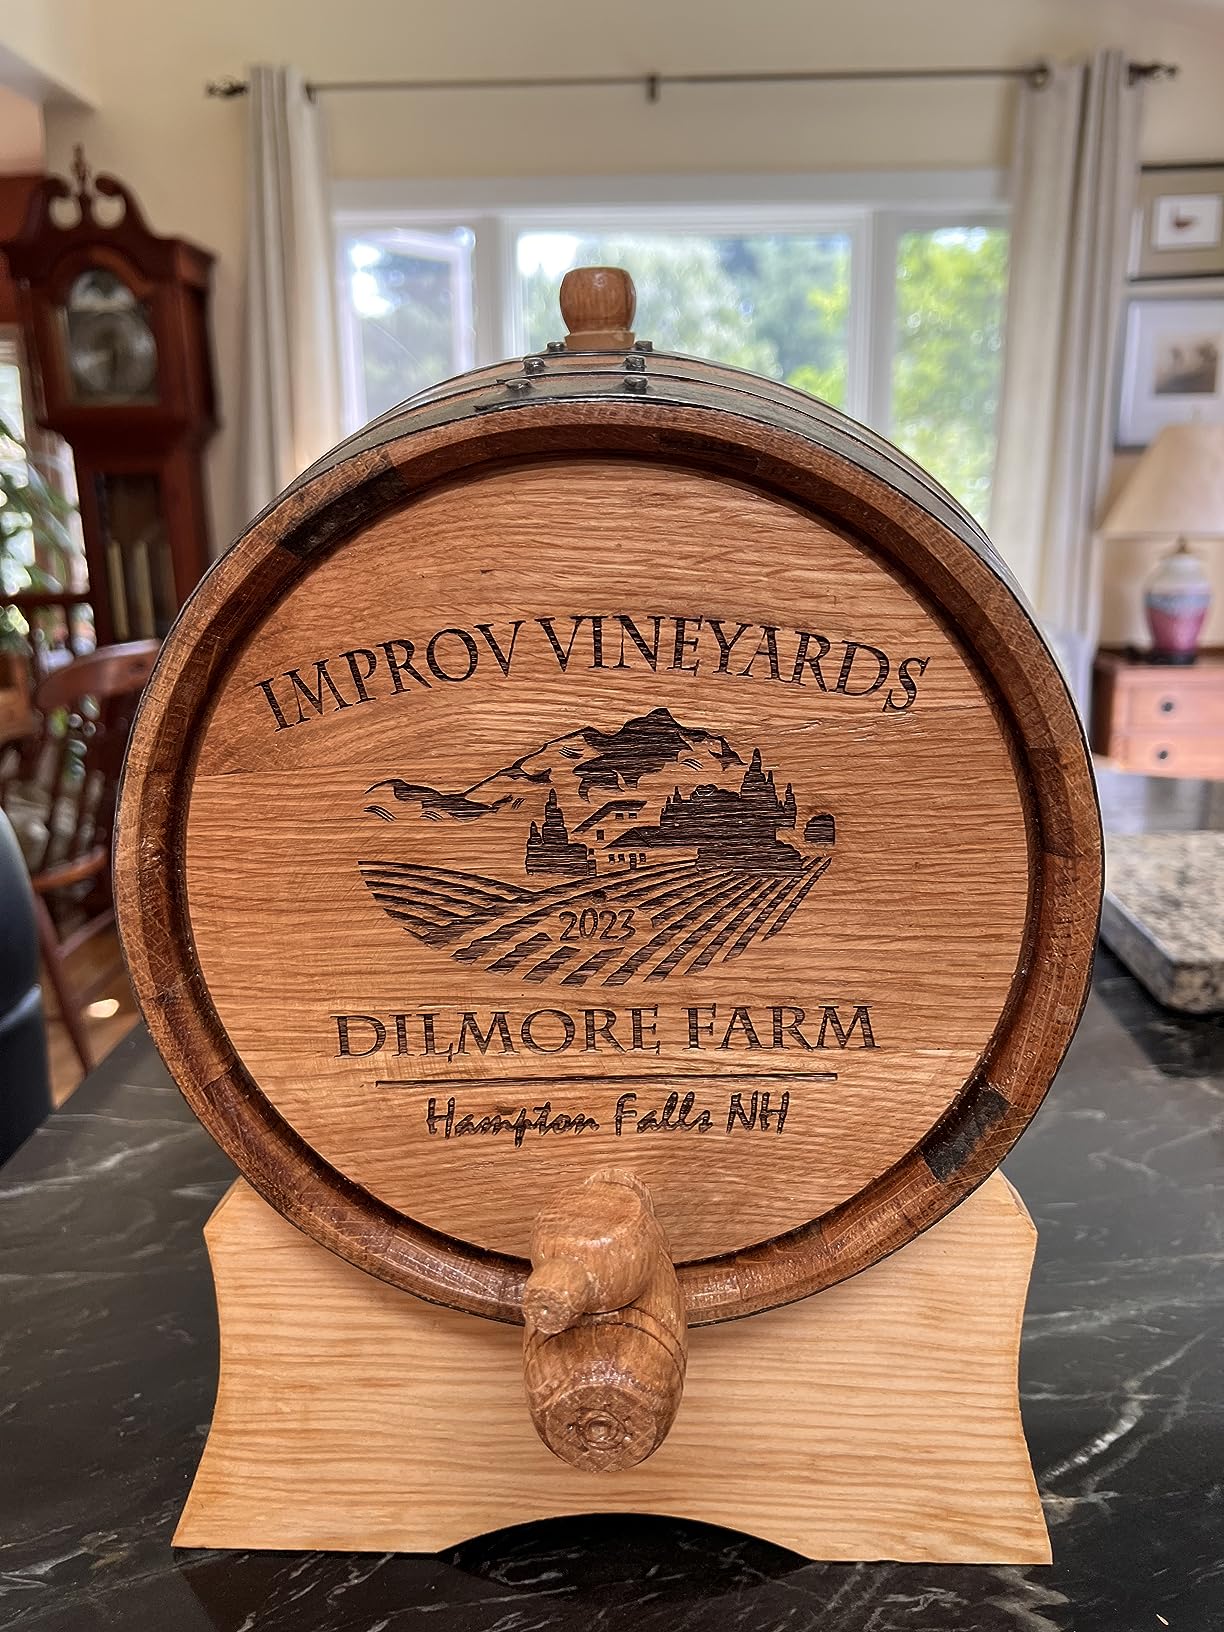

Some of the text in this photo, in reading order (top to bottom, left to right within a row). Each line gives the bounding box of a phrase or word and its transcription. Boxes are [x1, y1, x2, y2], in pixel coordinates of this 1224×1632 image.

[254, 614, 930, 732] IMPROV VINEYARDS
[558, 907, 637, 942] 2023
[330, 1002, 881, 1062] DILMORE FARM
[427, 1090, 790, 1148] Hampton Falls NH
